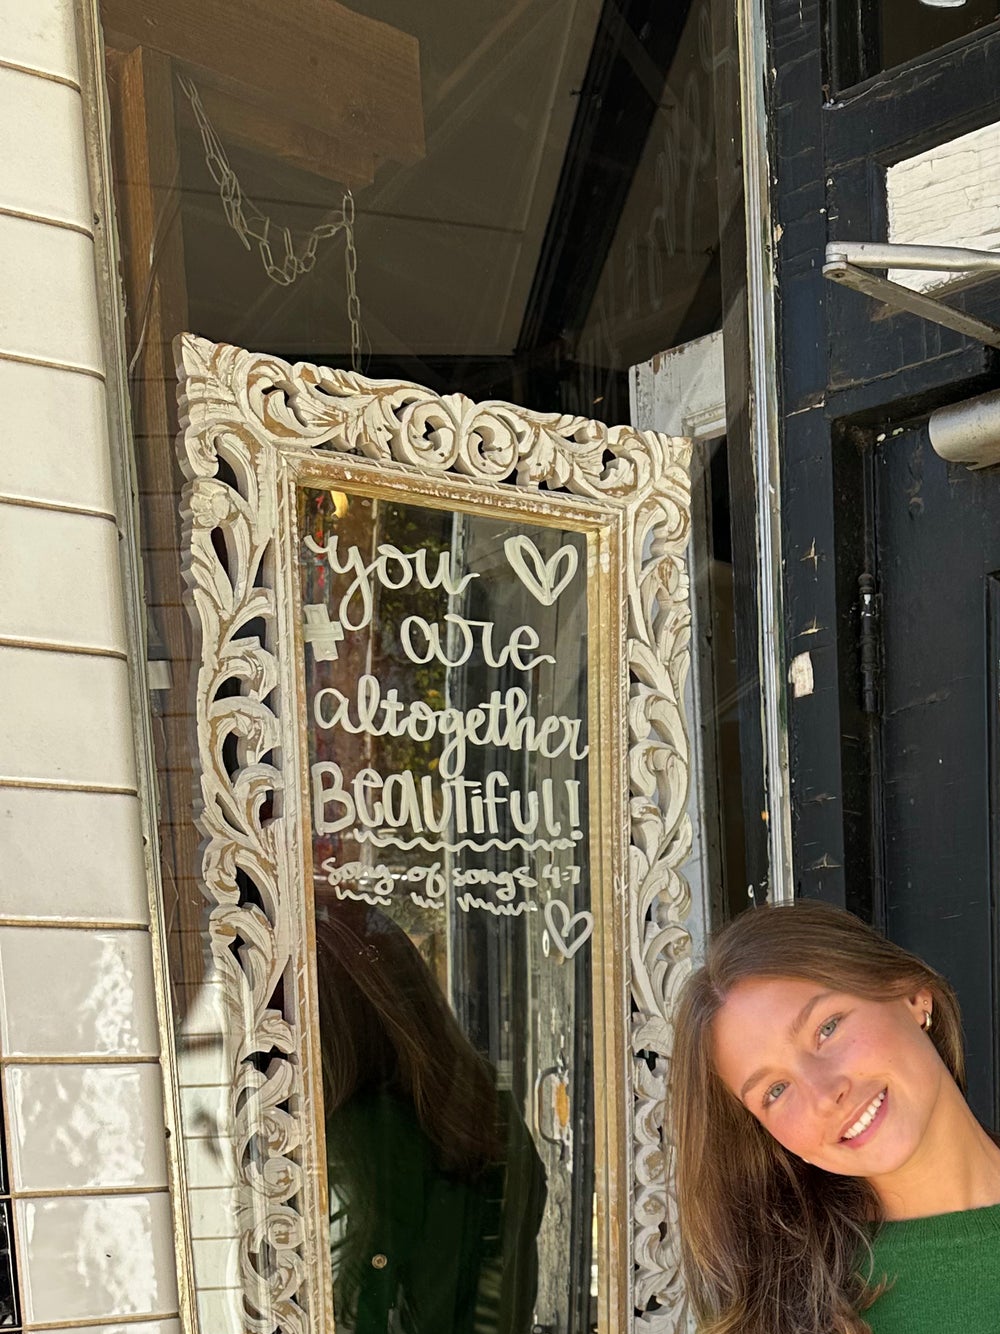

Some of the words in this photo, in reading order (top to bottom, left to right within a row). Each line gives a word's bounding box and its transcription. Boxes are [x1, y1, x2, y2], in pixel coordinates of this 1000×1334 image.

[303, 534, 480, 631] you
[400, 614, 556, 671] are
[313, 674, 589, 779] altogether
[407, 862, 447, 898] of
